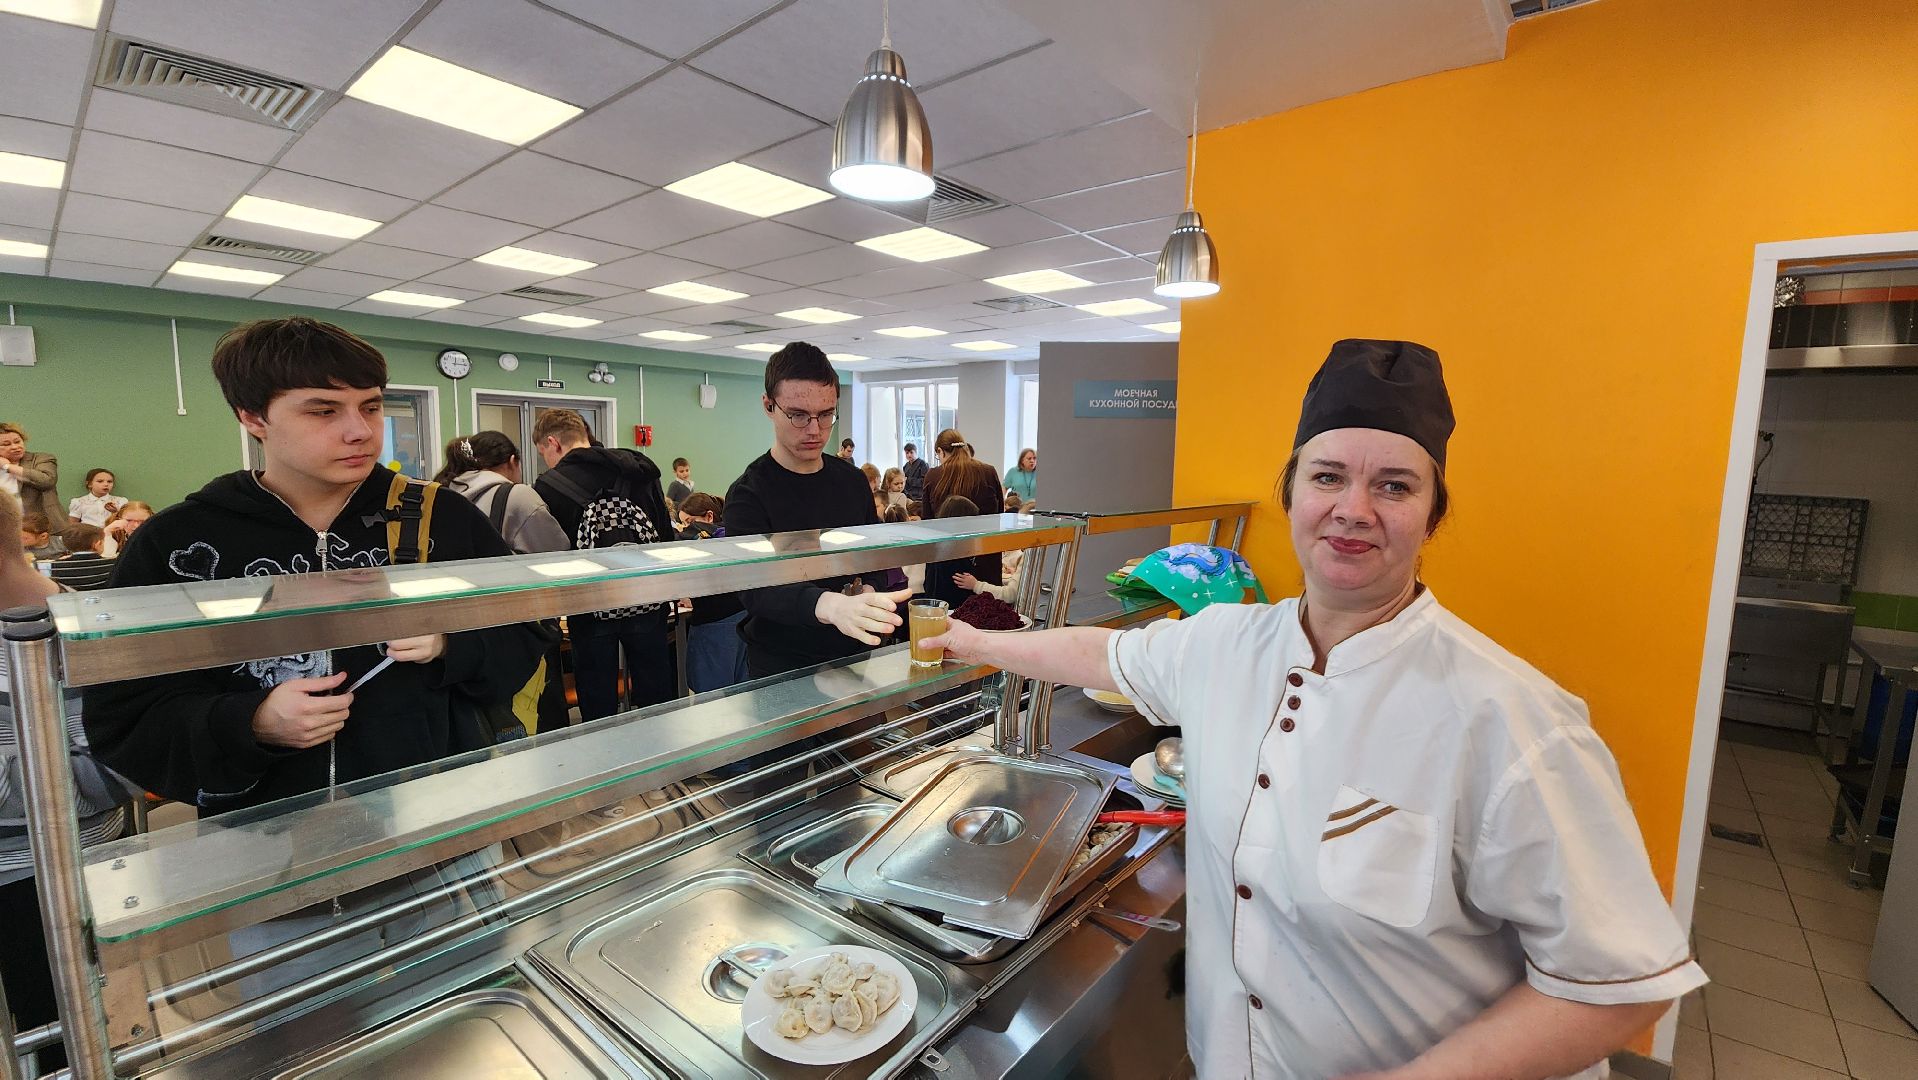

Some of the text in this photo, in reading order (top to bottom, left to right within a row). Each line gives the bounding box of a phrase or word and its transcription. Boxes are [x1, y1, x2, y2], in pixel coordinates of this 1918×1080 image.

[1114, 389, 1158, 397] МОЕЧНАЯ
[1089, 398, 1177, 409] КУХОННОЙ ПОСУД
